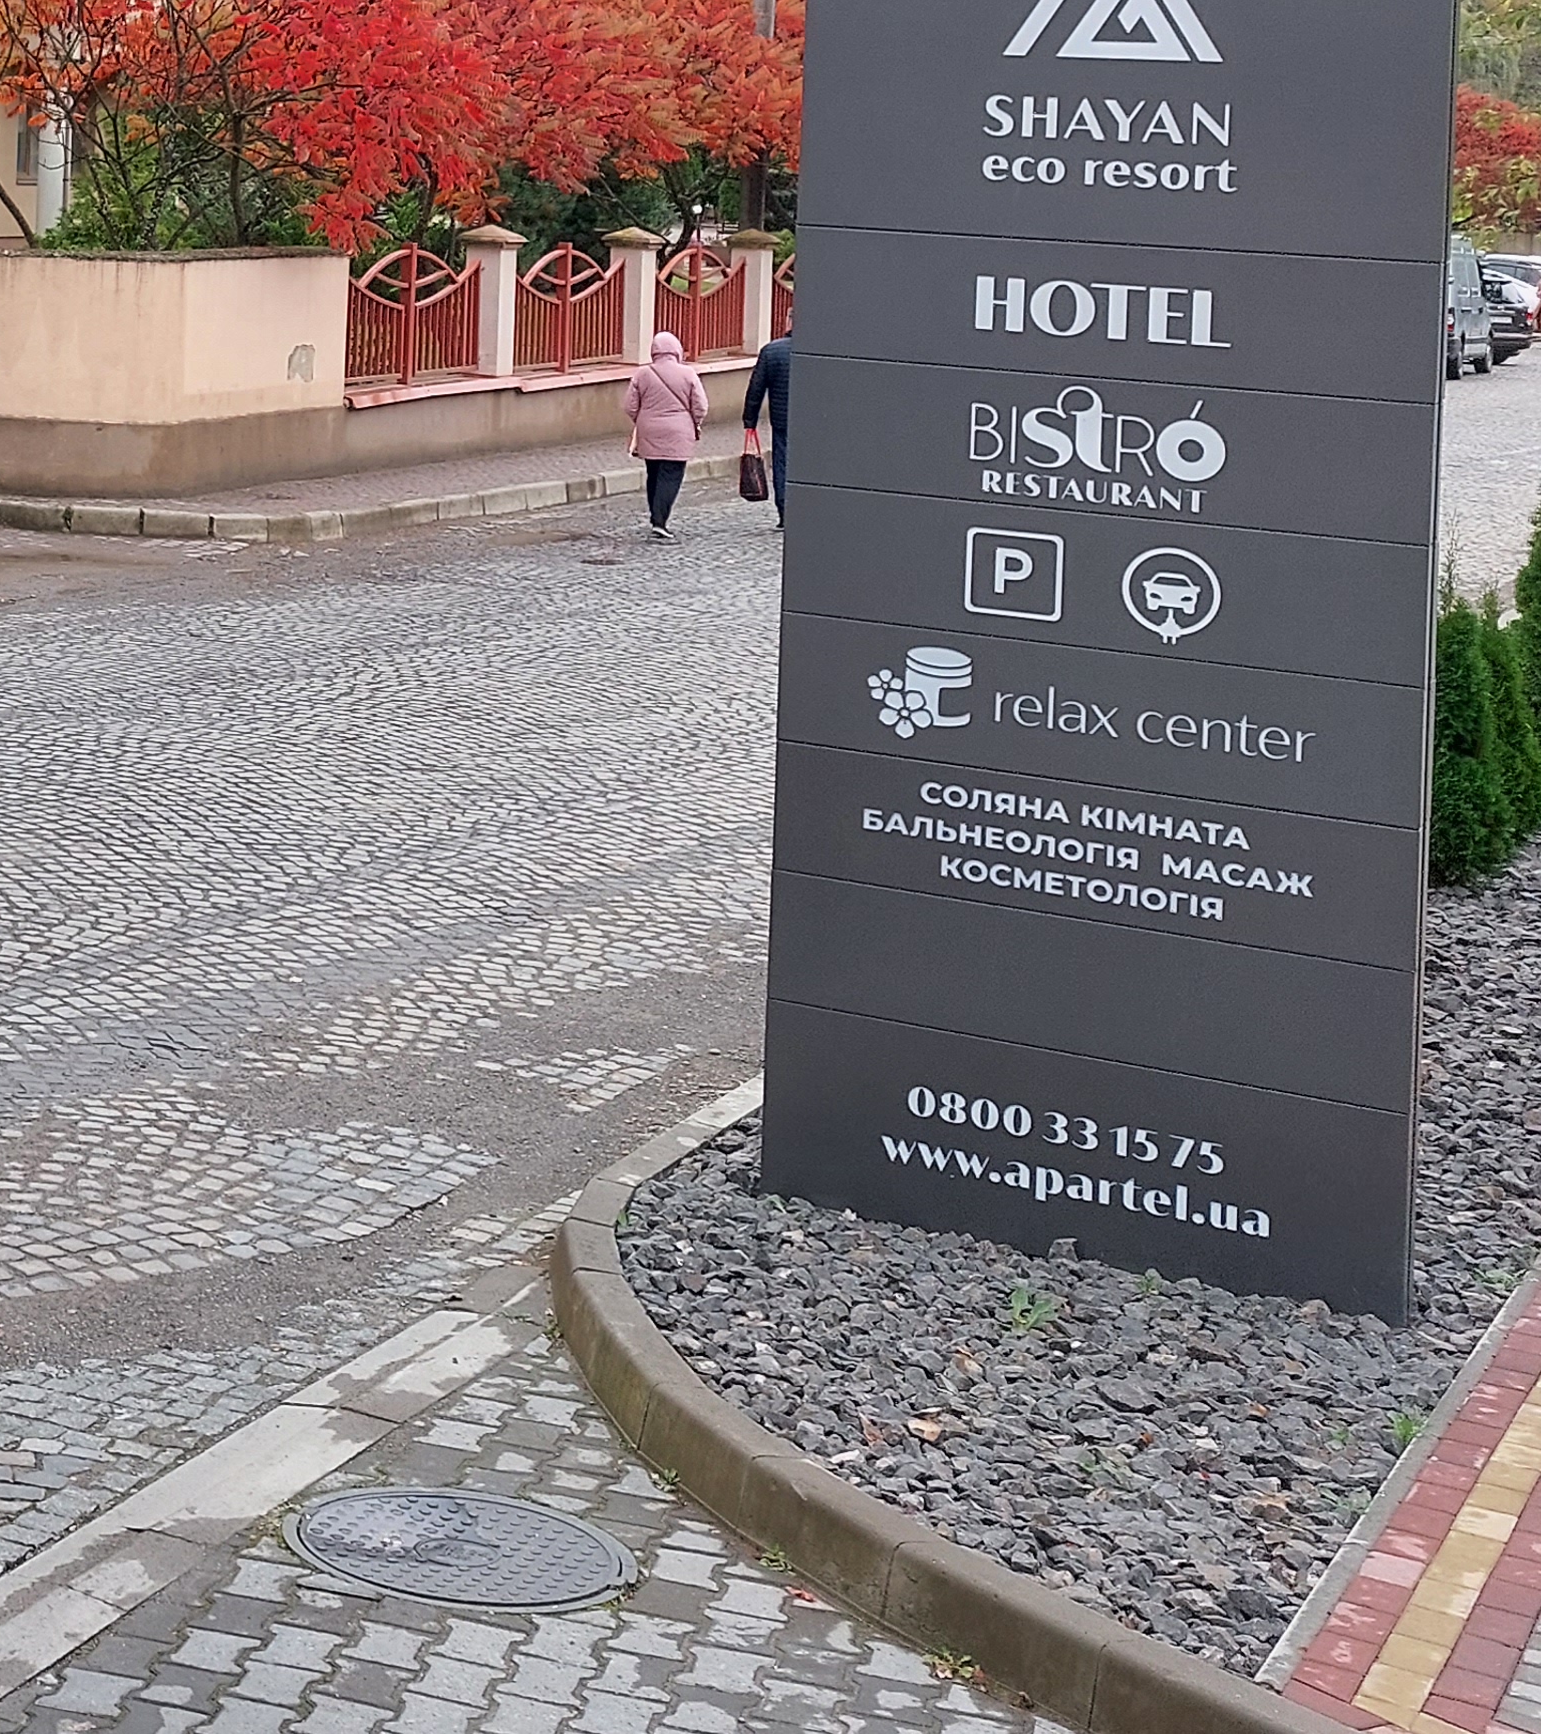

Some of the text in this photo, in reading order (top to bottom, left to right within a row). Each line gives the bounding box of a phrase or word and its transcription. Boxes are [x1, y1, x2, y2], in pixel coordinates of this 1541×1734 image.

[982, 94, 1232, 147] SHAYAN
[982, 155, 1238, 194] eco resort
[974, 275, 1233, 349] HOTEL
[981, 469, 1208, 514] RESTAURANT
[994, 546, 1034, 594] P
[994, 686, 1317, 763] relax center
[920, 781, 1252, 850] СОЛЯНА КІМНАТА
[862, 808, 1314, 898] БАЛЬНЕОЛОГІЯ МАСАЖ
[940, 855, 1225, 921] КОСМЕТОЛОГІЯ
[906, 1086, 1225, 1175] 0800 33 15 75
[880, 1135, 1271, 1238] www.apartel.ua
